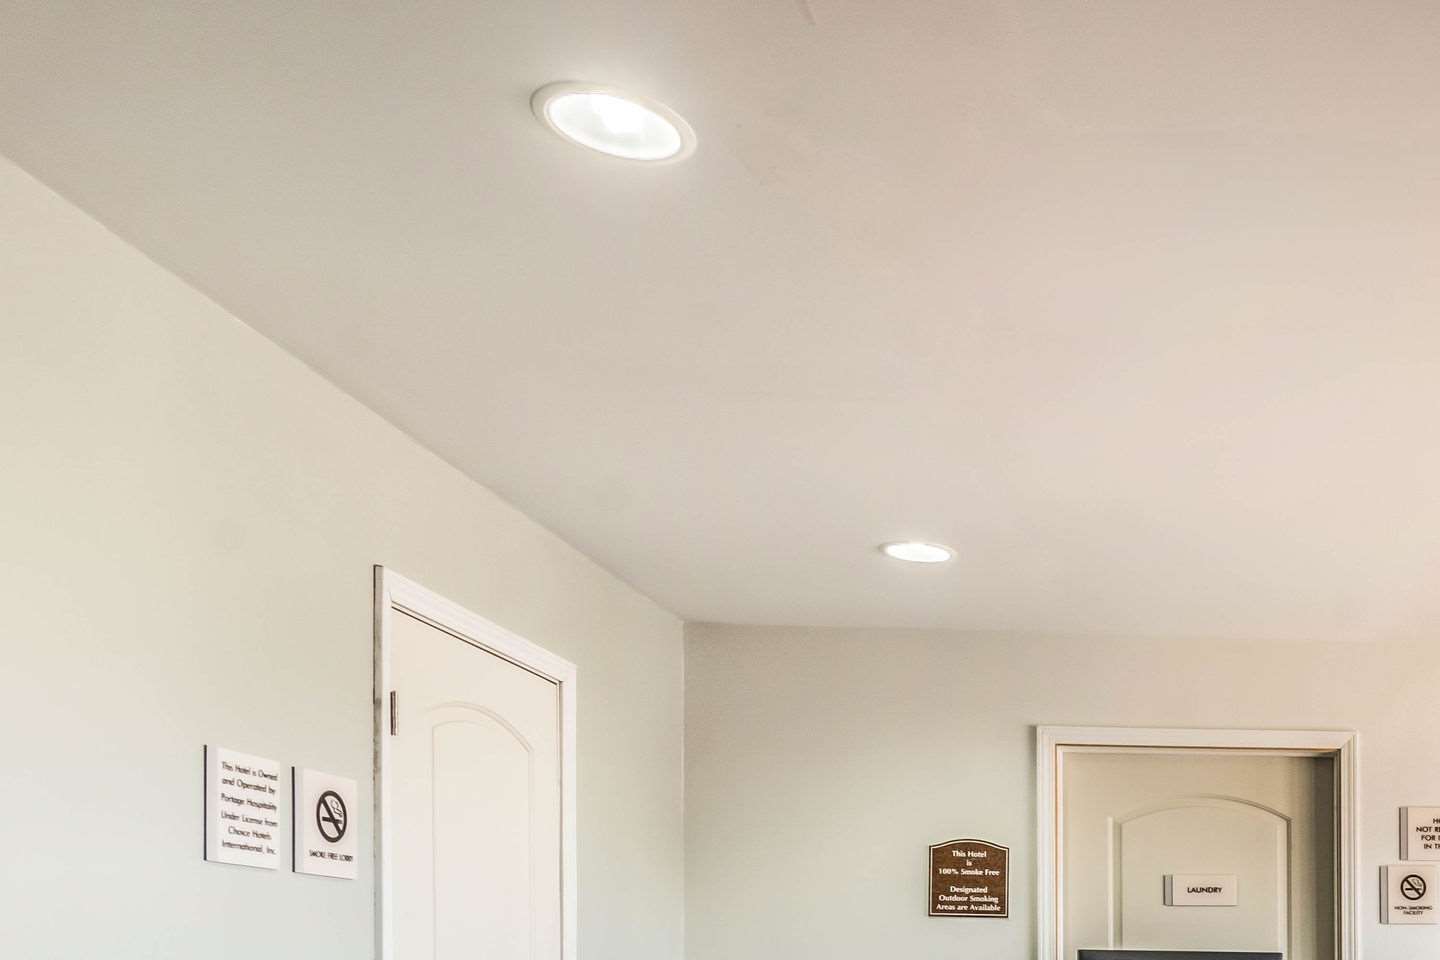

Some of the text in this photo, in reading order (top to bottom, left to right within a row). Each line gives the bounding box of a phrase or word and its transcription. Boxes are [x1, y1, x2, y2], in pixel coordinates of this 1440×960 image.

[237, 779, 267, 793] Operated
[952, 850, 987, 858] This Hotel
[960, 868, 983, 876] Smoke
[984, 868, 1000, 876] Free
[950, 886, 988, 894] Designated
[1187, 886, 1222, 894] LAUNDRY
[969, 895, 999, 904] Smoking
[936, 903, 955, 911] Areas
